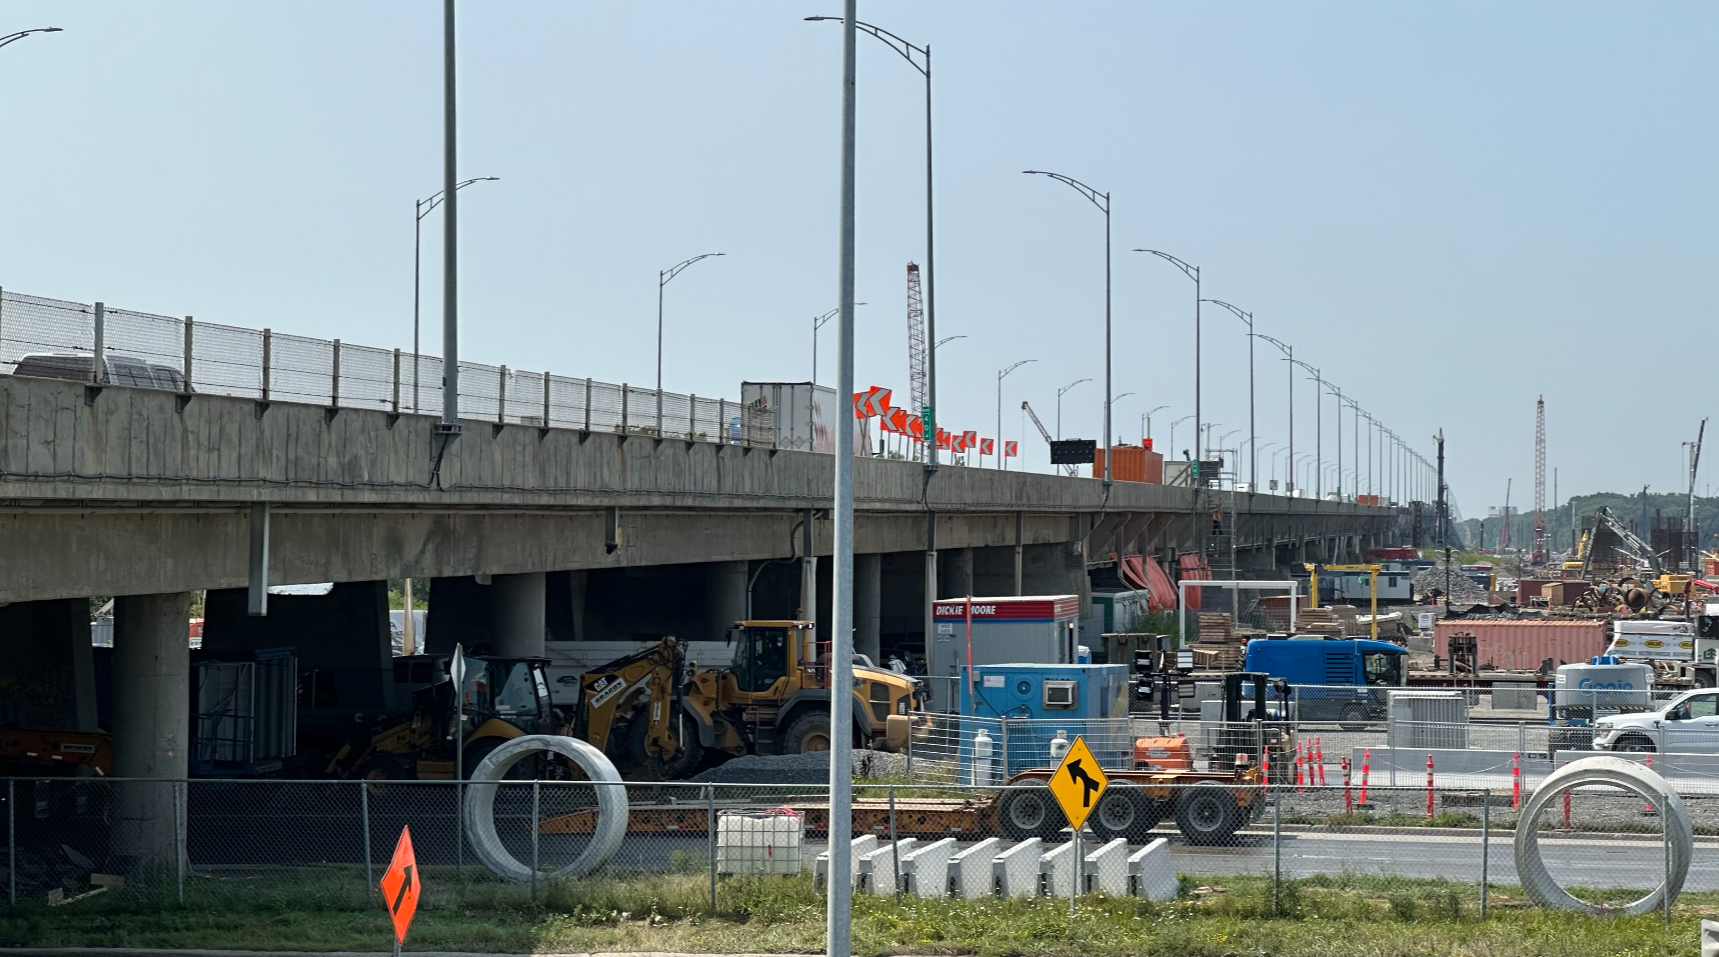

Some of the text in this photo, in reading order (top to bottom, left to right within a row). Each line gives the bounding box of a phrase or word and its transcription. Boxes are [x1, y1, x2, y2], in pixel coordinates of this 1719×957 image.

[936, 605, 963, 615] DICKIE
[594, 677, 608, 691] CAT
[1579, 678, 1633, 695] Genie
